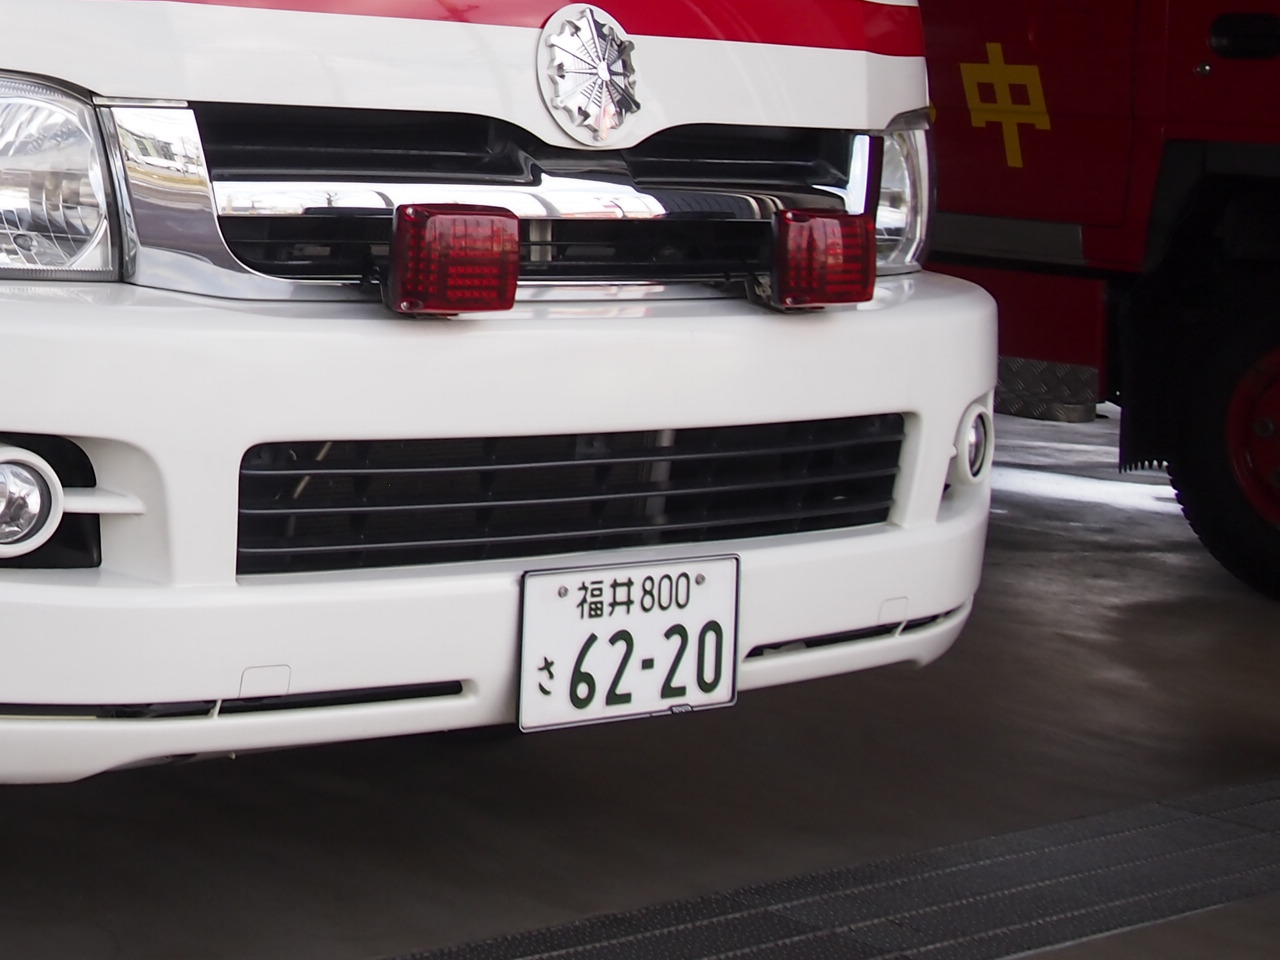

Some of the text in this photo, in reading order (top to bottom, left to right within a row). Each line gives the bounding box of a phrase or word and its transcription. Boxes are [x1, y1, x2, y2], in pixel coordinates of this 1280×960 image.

[959, 41, 1052, 169] 中
[537, 620, 724, 710] さ 62-20
